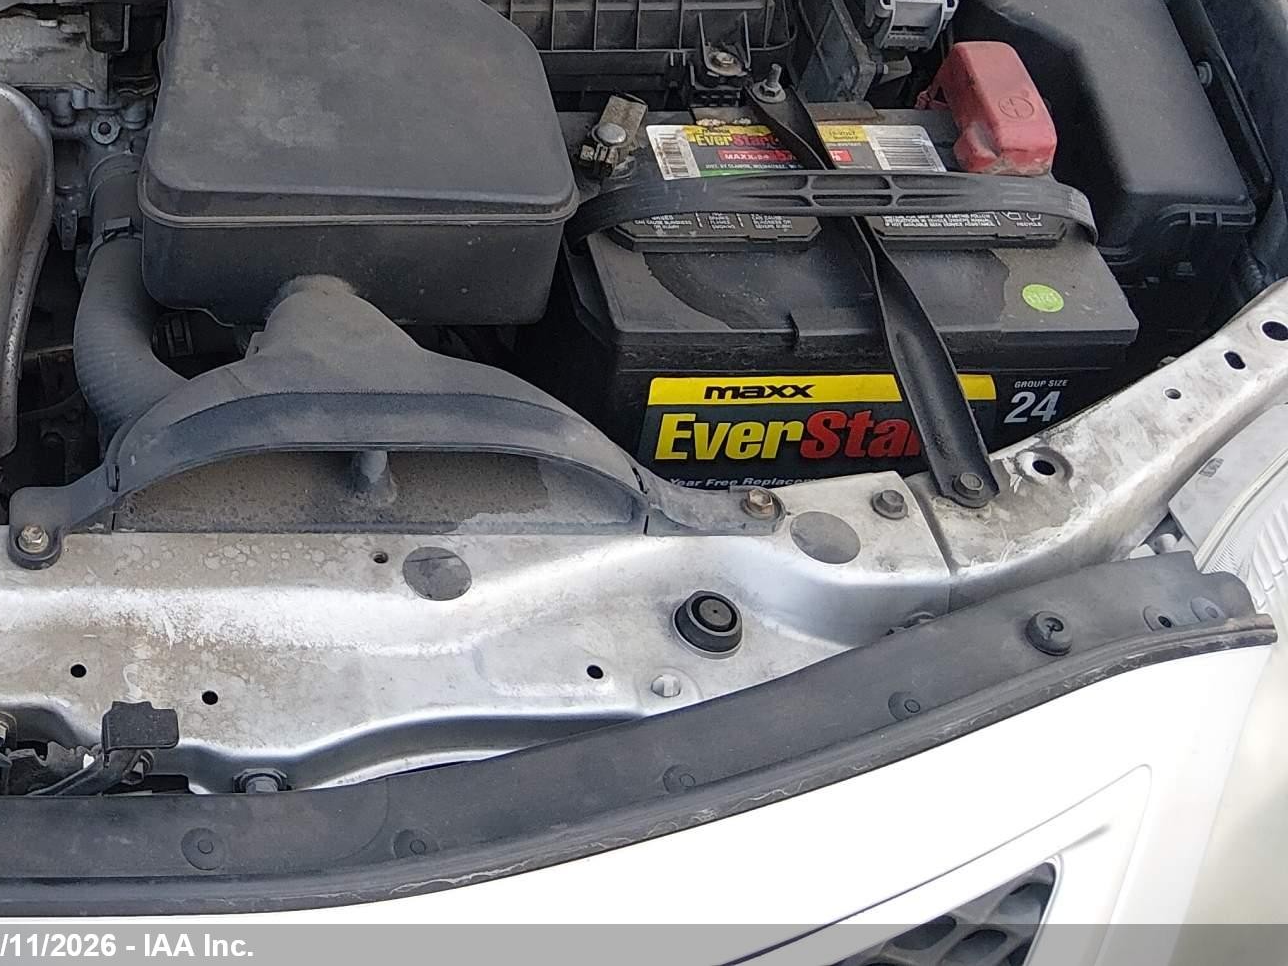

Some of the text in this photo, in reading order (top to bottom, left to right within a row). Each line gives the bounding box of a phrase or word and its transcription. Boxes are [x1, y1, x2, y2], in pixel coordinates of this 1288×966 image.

[703, 384, 813, 400] maxx
[1014, 379, 1069, 389] GROUP SIZE
[1003, 390, 1059, 424] 24
[653, 410, 921, 461] EverSta
[706, 478, 738, 487] Free
